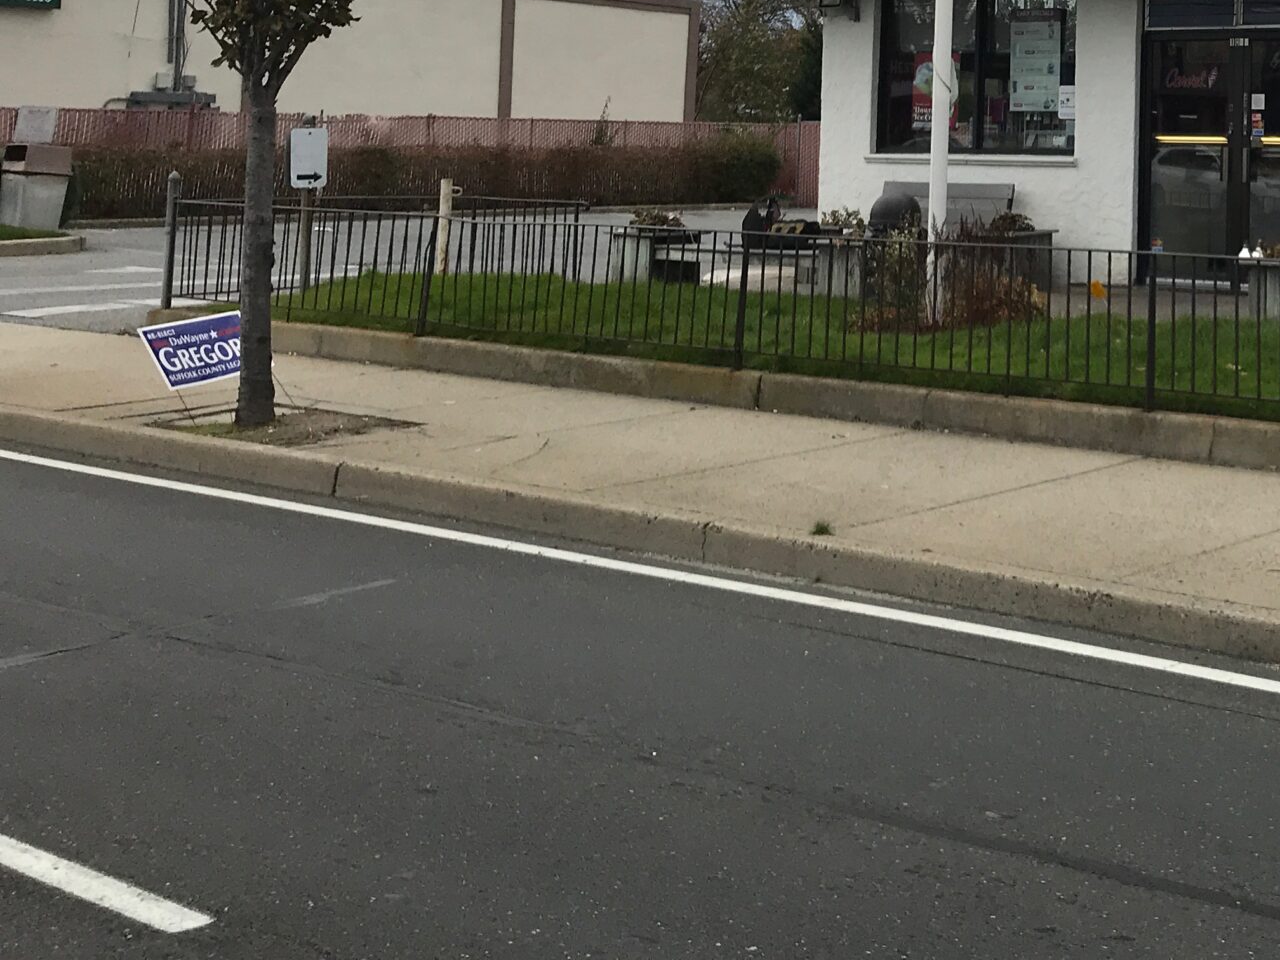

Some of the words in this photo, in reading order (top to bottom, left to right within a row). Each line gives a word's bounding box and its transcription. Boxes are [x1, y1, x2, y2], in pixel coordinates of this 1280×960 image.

[147, 329, 175, 339] RE-ELECT
[169, 333, 209, 346] DuWayne
[159, 337, 240, 371] GREGOR
[169, 370, 198, 381] SUFFOLK
[198, 365, 226, 376] COUNTY
